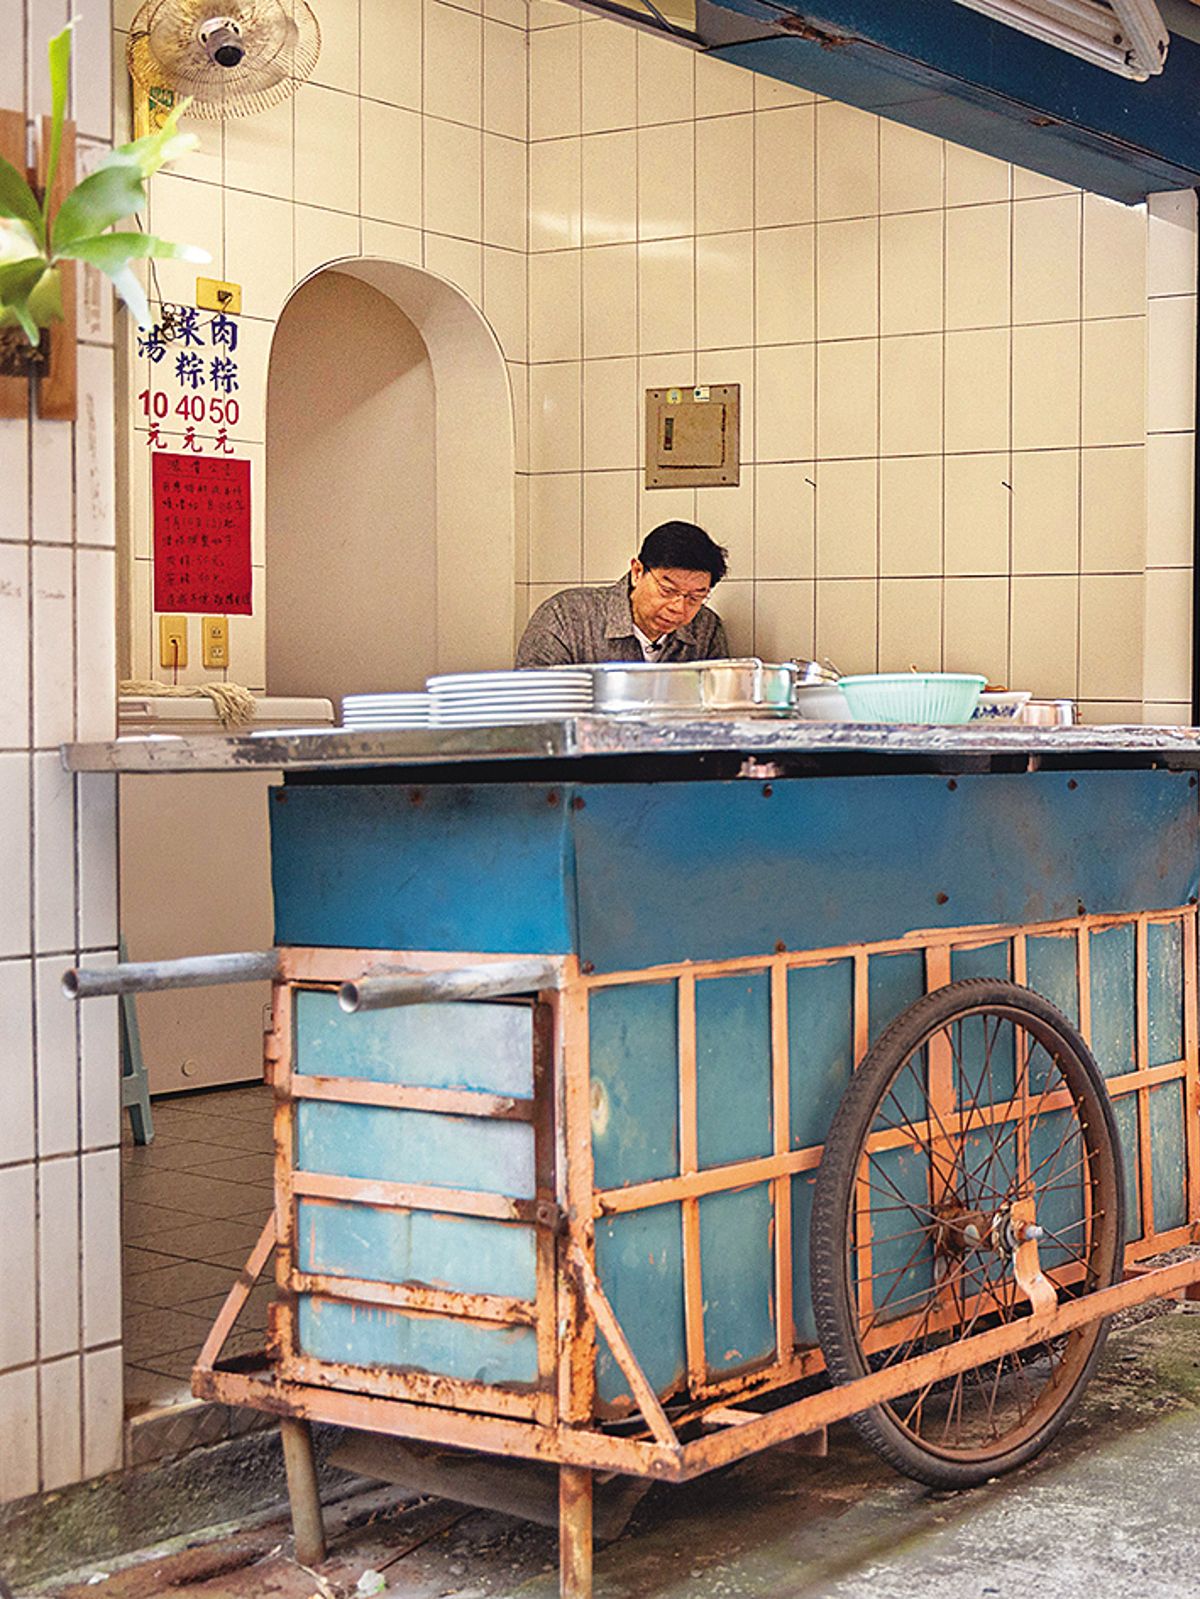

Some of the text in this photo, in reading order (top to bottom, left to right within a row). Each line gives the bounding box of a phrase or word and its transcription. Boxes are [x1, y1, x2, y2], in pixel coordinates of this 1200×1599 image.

[137, 325, 169, 450] 湯 10 元
[175, 394, 206, 422] 40
[209, 314, 240, 454] 肉粽 50 元
[182, 425, 203, 453] 元
